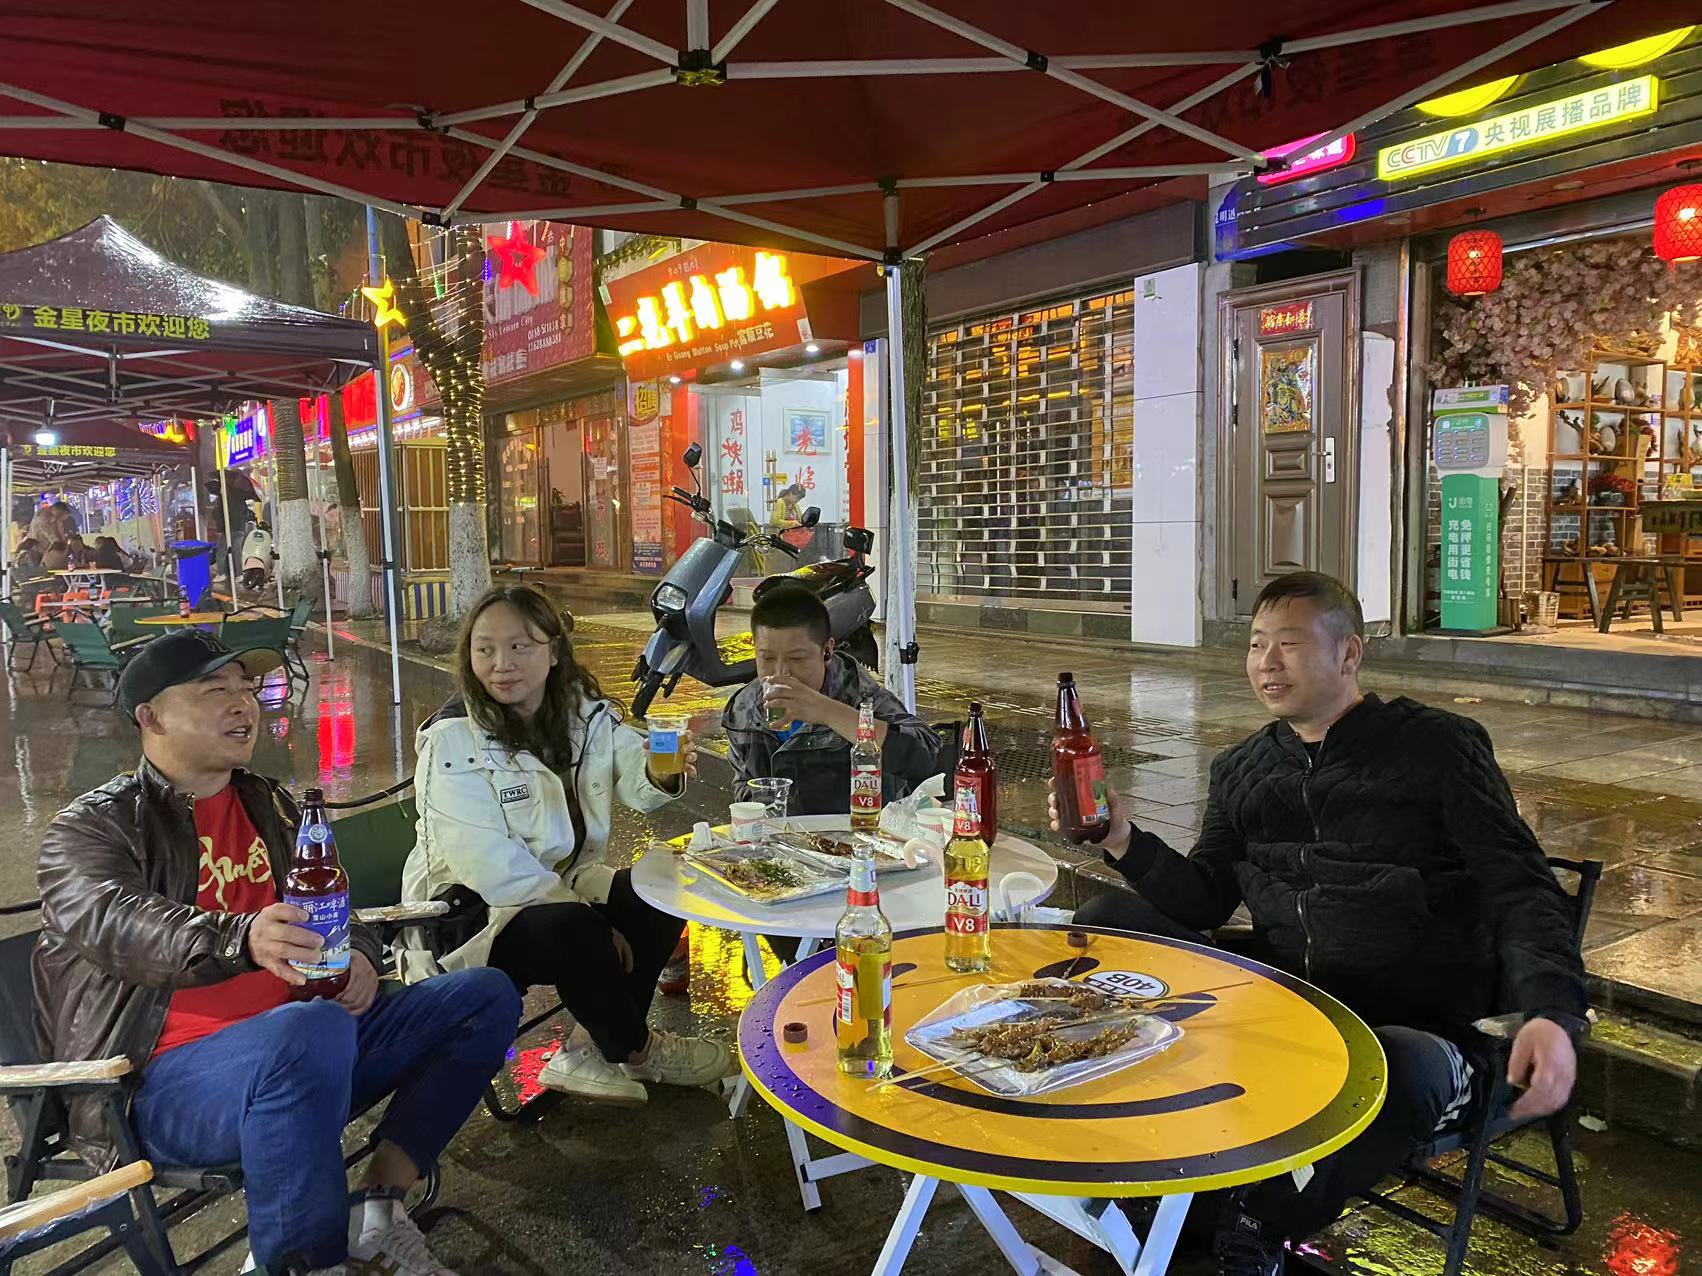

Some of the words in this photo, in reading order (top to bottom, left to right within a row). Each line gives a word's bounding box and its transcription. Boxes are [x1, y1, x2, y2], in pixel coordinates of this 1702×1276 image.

[1485, 83, 1643, 146] 央视展播品牌
[33, 305, 211, 340] 金星夜市欢迎您
[674, 350, 691, 359] Guang
[635, 388, 659, 418] 招聘
[1448, 519, 1459, 580] 充电用街电
[1460, 519, 1472, 580] 免押更省钱
[861, 728, 871, 737] V8
[854, 780, 878, 790] DALI
[503, 787, 527, 798] TWRC
[859, 796, 874, 807] V8
[957, 820, 971, 831] V8
[948, 892, 981, 907] DALI
[953, 918, 975, 932] V8
[1106, 973, 1156, 990] 40B
[1240, 1217, 1258, 1230] FILA
